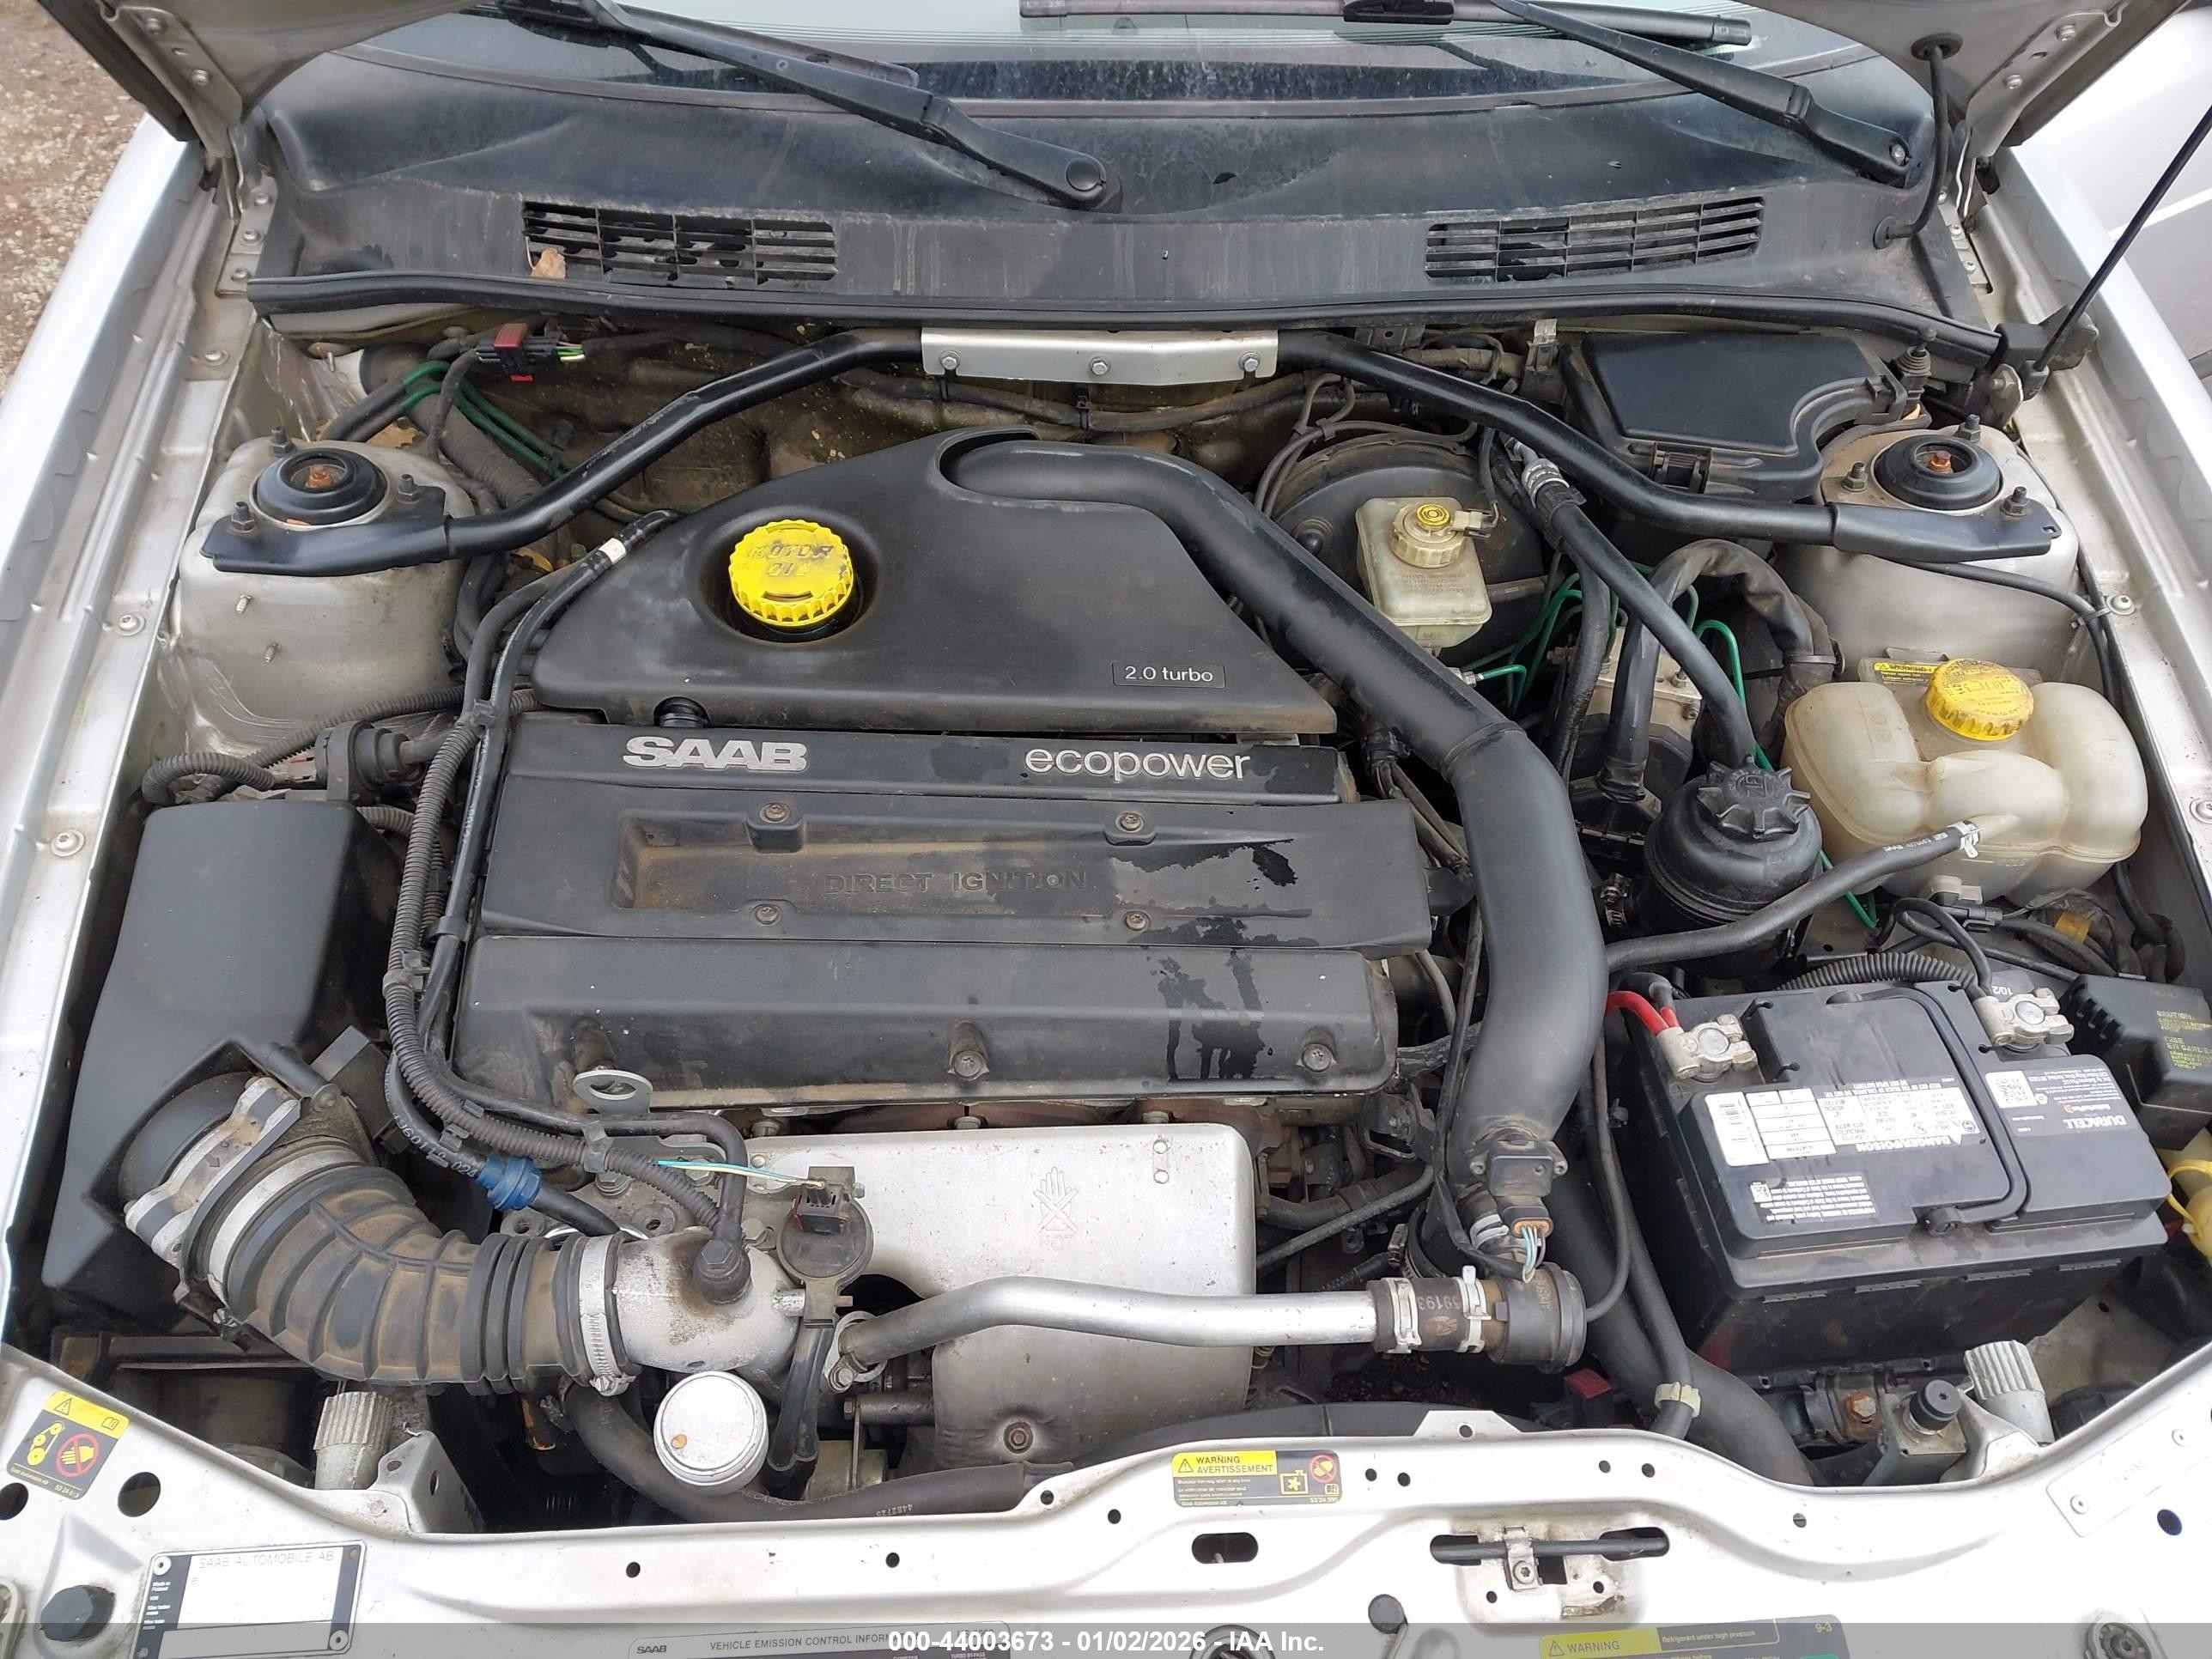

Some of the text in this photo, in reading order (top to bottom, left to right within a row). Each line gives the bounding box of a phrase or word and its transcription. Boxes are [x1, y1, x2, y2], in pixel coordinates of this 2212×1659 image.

[748, 540, 833, 560] MOTOR
[765, 562, 811, 578] OIL
[1124, 665, 1214, 684] 2.0 turbo
[622, 735, 808, 772] SAAB
[1024, 745, 1251, 783] ecopower
[824, 867, 1087, 896] DIRECT IGNITION
[2063, 1115, 2127, 1129] DURACELL
[1039, 1235, 1073, 1252] HOT
[1196, 1455, 1241, 1465] WARNING
[1197, 1463, 1273, 1474] AVERTISSEMENT
[198, 1551, 335, 1569] SAAB AUTOMOBILE AB
[1814, 1621, 1833, 1633] 9-3
[636, 1644, 667, 1655] SAAB
[709, 1641, 751, 1651] VEHICLE
[754, 1638, 802, 1650] EMISSION
[805, 1636, 853, 1647] CONTROL
[1566, 1640, 1620, 1654] WARNING
